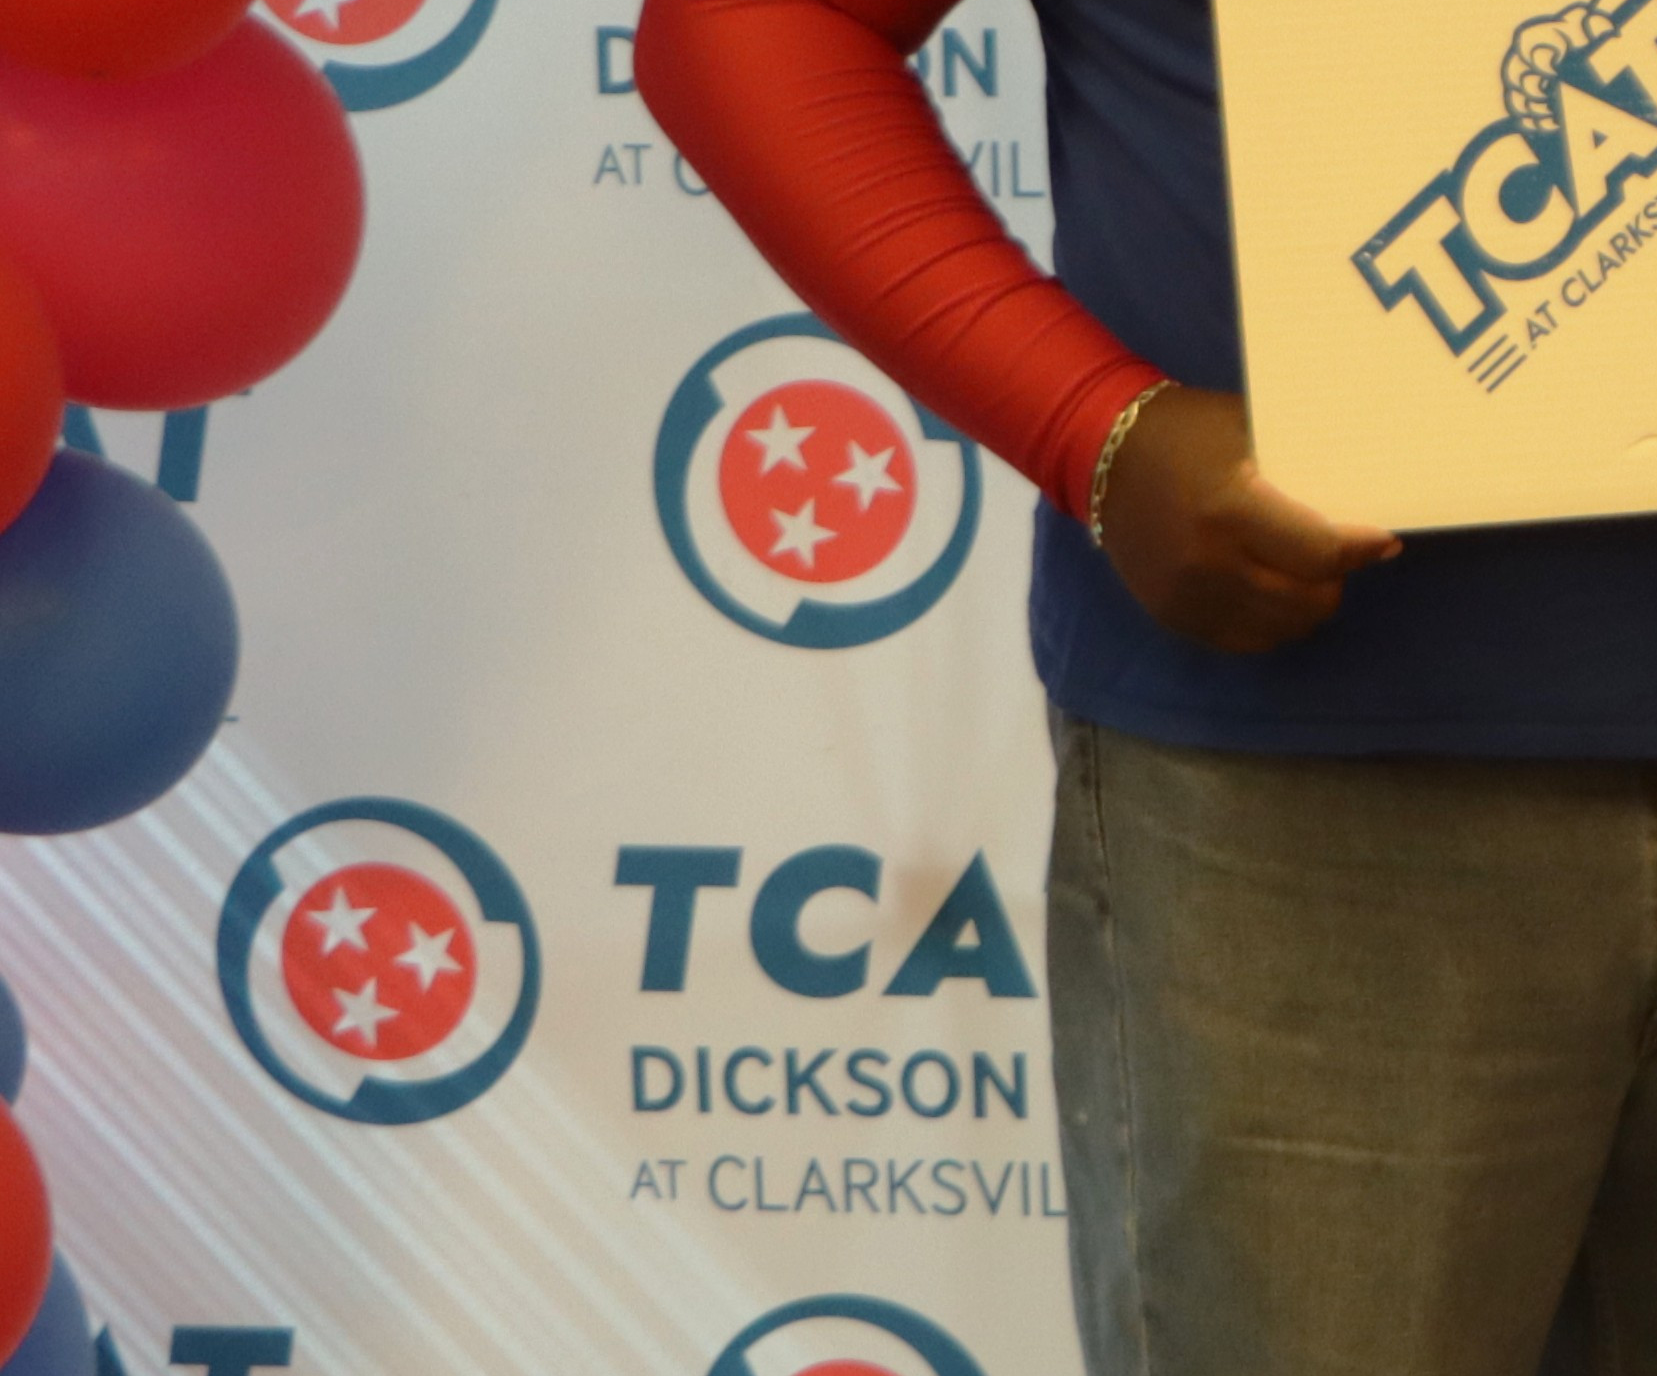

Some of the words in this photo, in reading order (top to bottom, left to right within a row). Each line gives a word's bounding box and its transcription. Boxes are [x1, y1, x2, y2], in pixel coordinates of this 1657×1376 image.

[593, 143, 653, 186] AT
[1526, 300, 1558, 349] AT
[613, 842, 1040, 999] TCA
[630, 1045, 1028, 1120] DICKSON
[630, 1159, 688, 1201] AT
[708, 1155, 1069, 1218] CLARKSVIL
